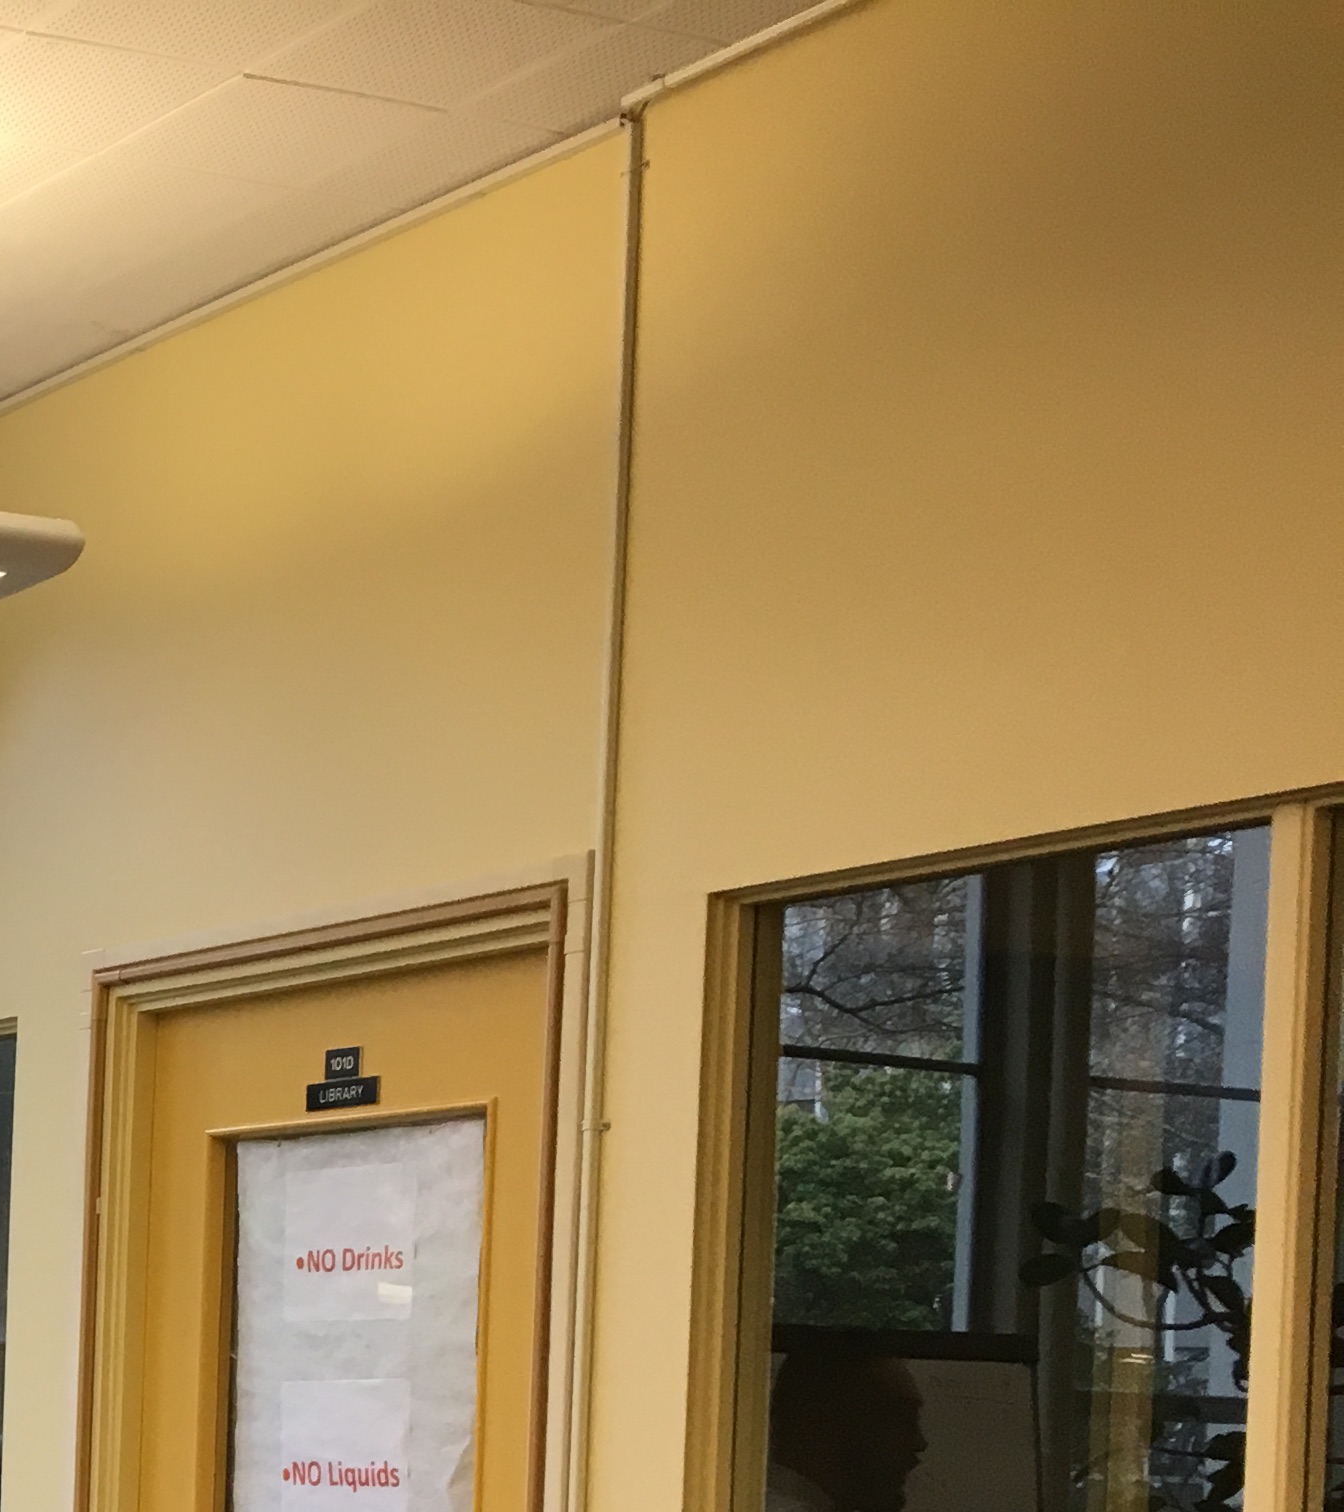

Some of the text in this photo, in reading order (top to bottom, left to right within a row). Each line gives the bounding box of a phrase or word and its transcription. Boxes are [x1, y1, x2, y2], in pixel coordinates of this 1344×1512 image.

[318, 1085, 364, 1103] LIBRARY
[307, 1245, 404, 1272] NO Drinks
[291, 1460, 401, 1493] NO Liquids
